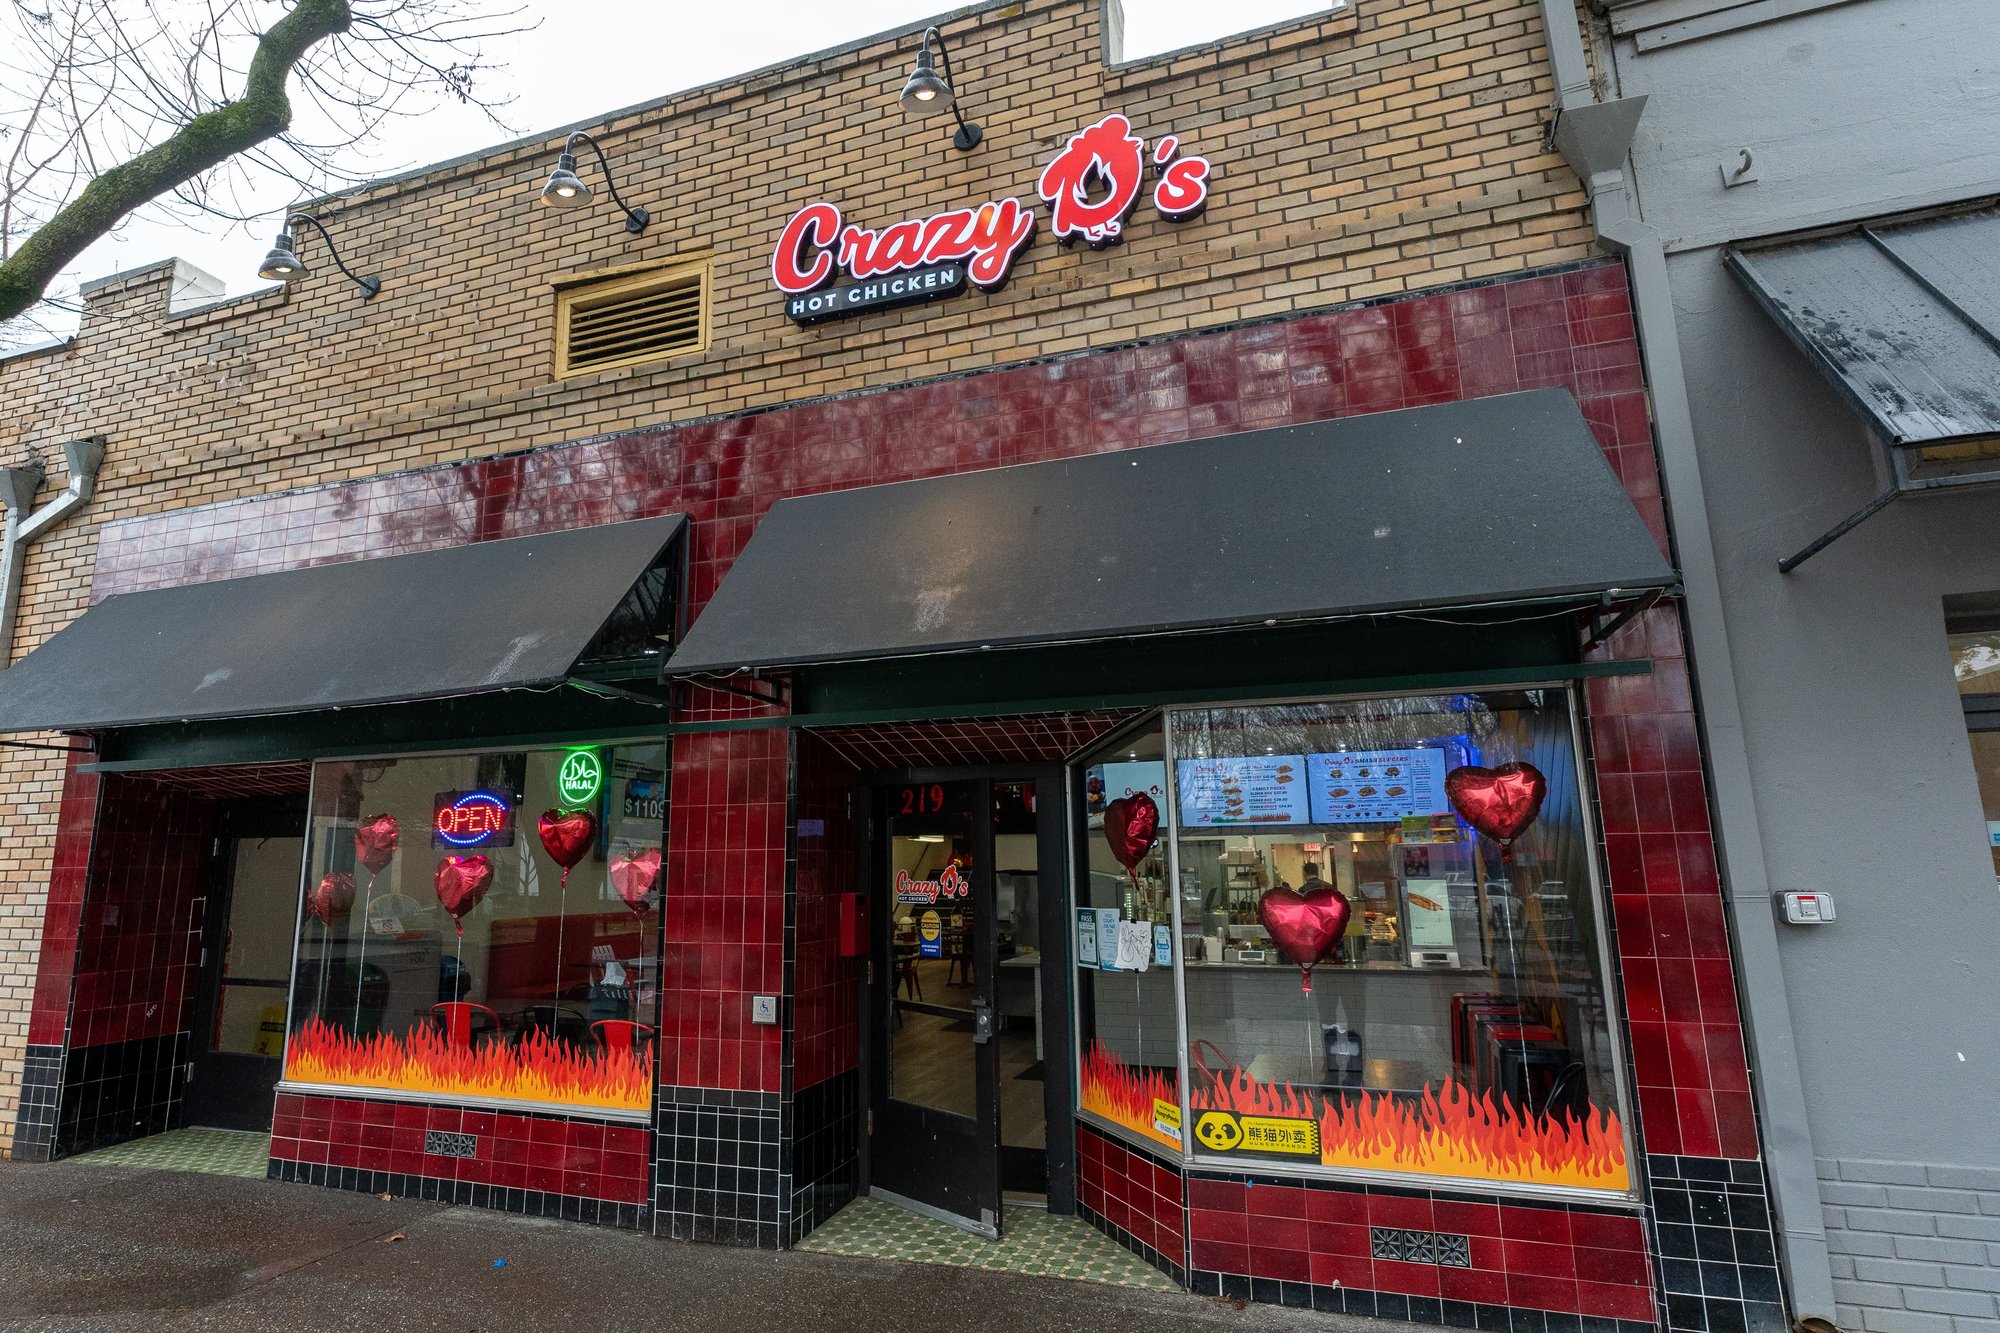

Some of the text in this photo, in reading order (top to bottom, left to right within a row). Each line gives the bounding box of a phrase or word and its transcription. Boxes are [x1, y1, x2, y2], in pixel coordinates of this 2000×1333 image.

[772, 113, 1211, 293] Crazy O's
[791, 269, 956, 316] HOT CHICKEN
[563, 758, 599, 780] حلال
[565, 779, 594, 791] HALAL
[900, 783, 944, 815] 219
[437, 805, 501, 832] OPEN
[895, 864, 968, 904] Crazy O's
[1080, 914, 1093, 923] PASS
[1248, 1127, 1307, 1145] 熊猫外卖
[1249, 1141, 1307, 1149] HUNGRYPANDA
